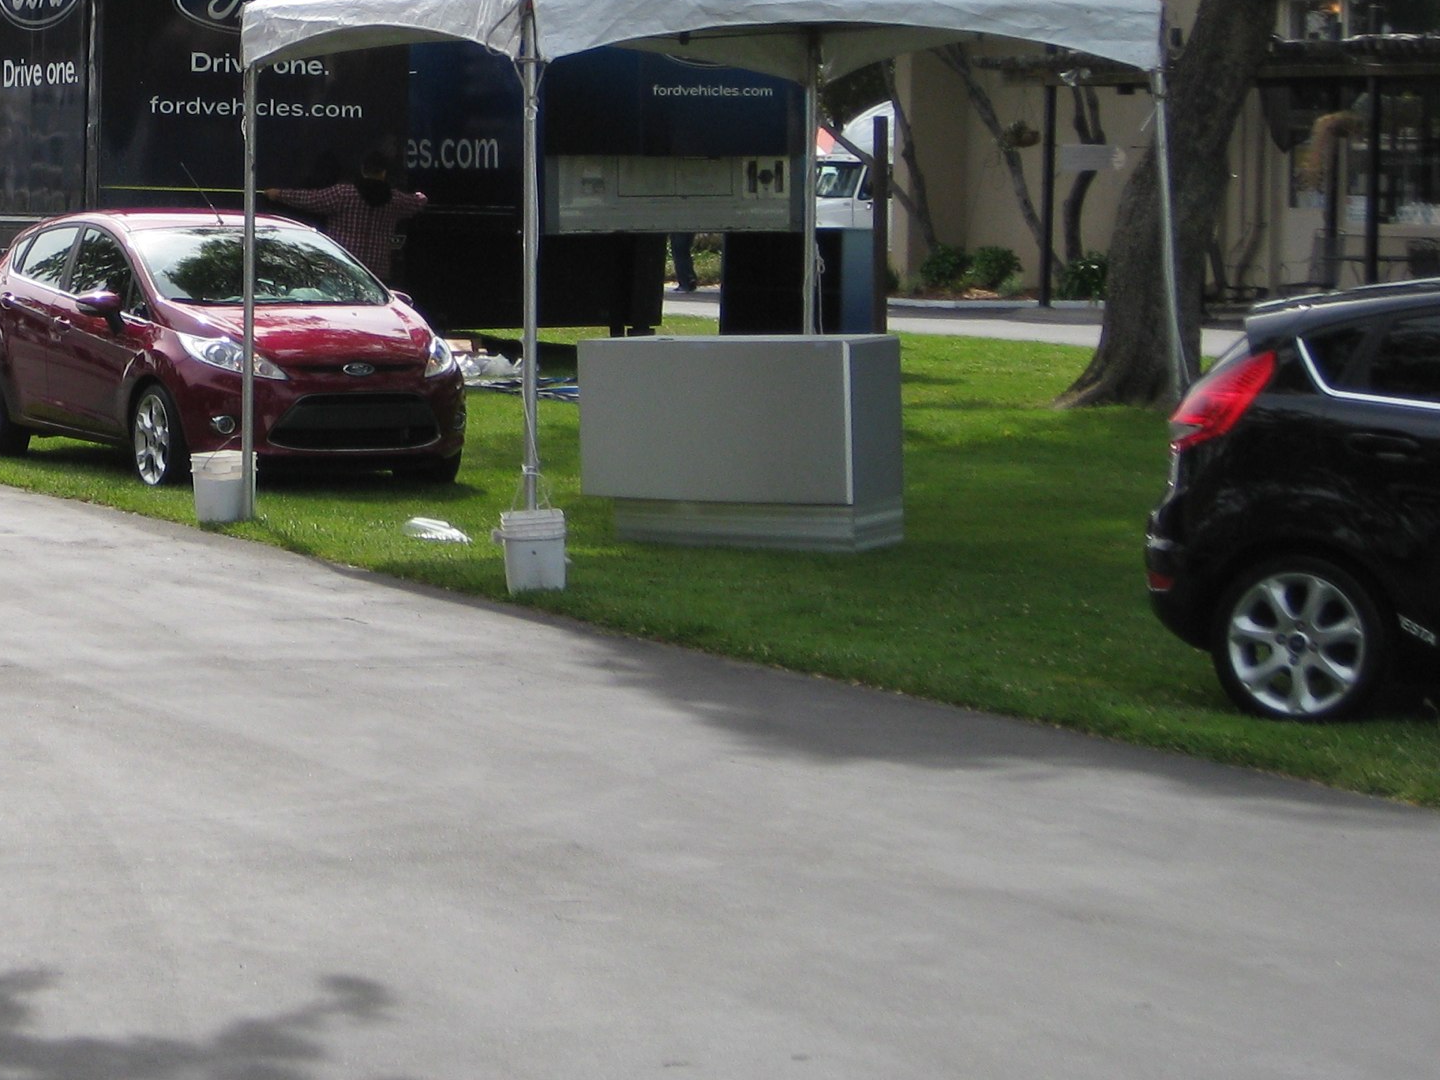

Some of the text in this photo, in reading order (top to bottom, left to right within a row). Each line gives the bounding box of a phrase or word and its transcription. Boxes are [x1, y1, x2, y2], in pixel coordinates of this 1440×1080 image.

[3, 58, 79, 88] Drive one.
[191, 51, 329, 75] Driv one.
[652, 84, 773, 97] fordvehicles.com
[150, 95, 363, 119] fordvehcles.com
